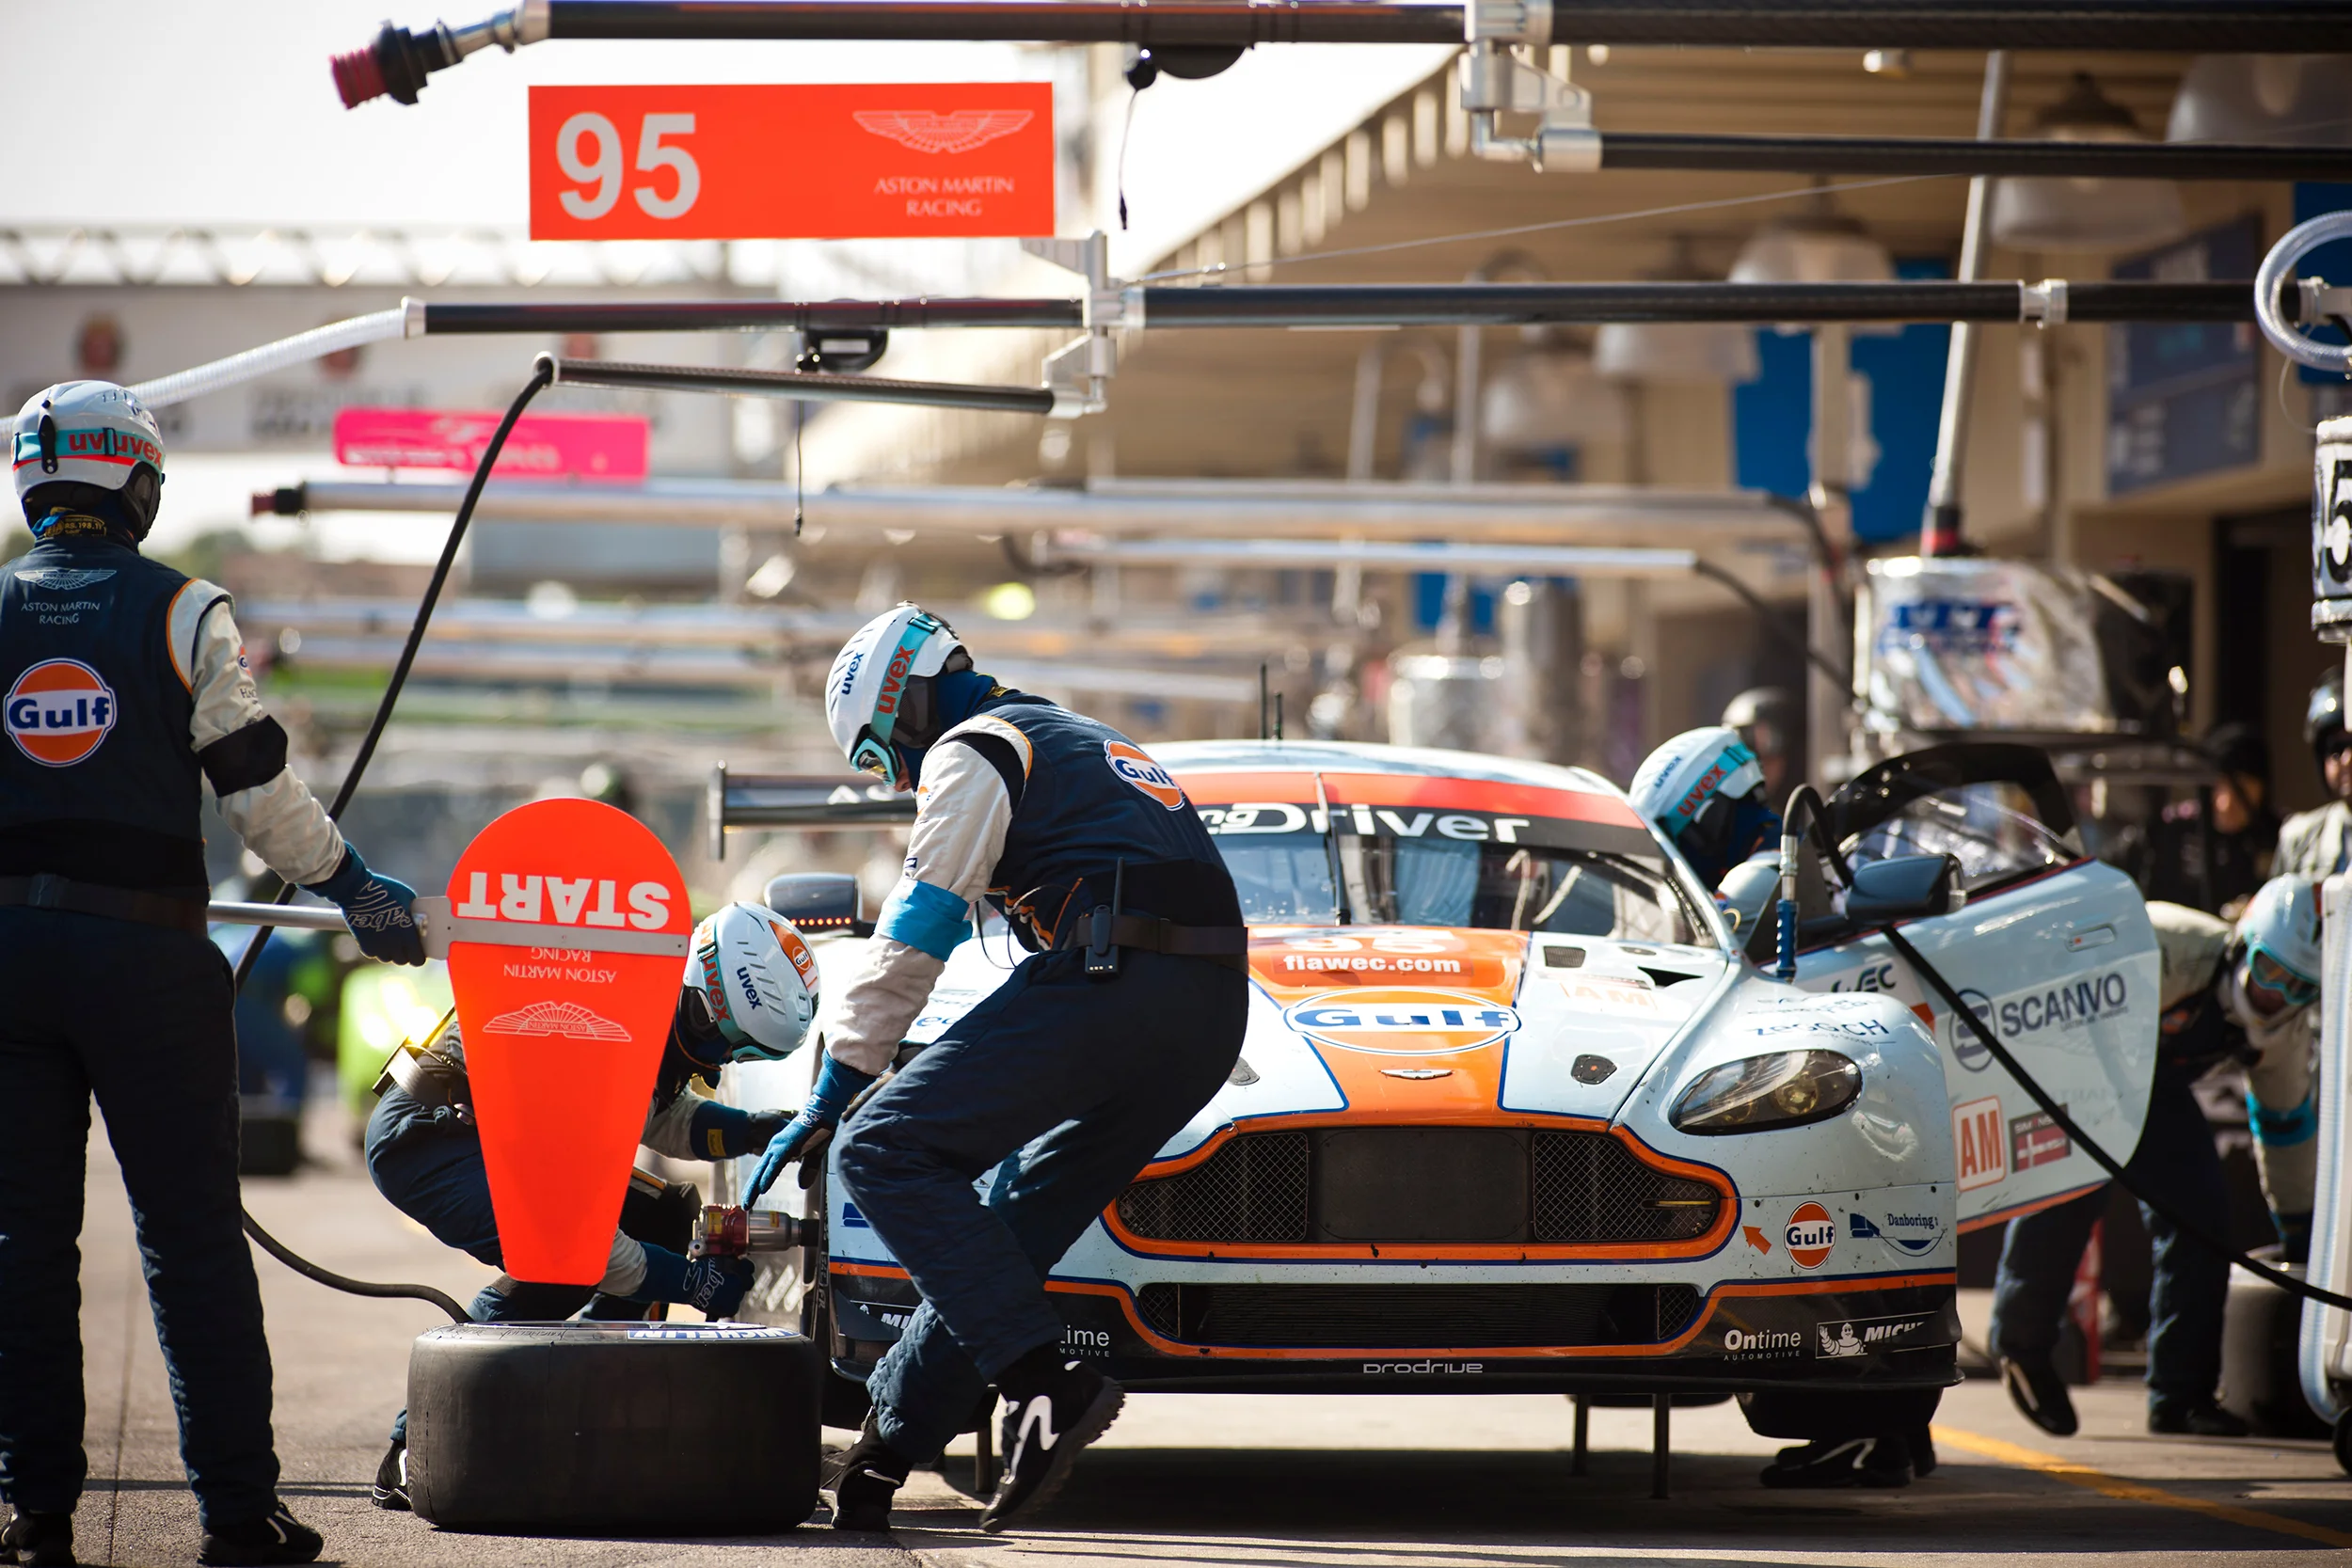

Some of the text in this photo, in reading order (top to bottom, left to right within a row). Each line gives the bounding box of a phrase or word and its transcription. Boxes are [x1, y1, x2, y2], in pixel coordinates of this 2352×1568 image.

[555, 111, 701, 220] 95
[873, 175, 1015, 195] ASTON MARTIN
[906, 198, 982, 217] RACING
[69, 433, 105, 452] uv
[115, 435, 163, 469] uvex
[21, 601, 101, 612] ASTON MARTIN
[39, 613, 80, 626] RACING
[841, 652, 865, 695] uvex
[877, 645, 916, 714] uvex
[8, 697, 110, 729] Gulf
[1115, 759, 1176, 786] Gulf
[1654, 755, 1682, 788] uvex
[1677, 764, 1726, 816] uvex
[1231, 802, 1530, 843] Driver
[457, 871, 671, 930] START
[531, 946, 591, 962] RACING
[795, 952, 809, 965] Gulf
[1283, 955, 1461, 973] fiawec.com
[503, 963, 617, 984] ASTON MARTIN
[703, 954, 731, 1023] uvex
[737, 967, 763, 1010] uvex
[1575, 986, 1649, 1006] AM
[2000, 973, 2126, 1037] SCANVO
[560, 1023, 587, 1033] ASTON
[1294, 1008, 1510, 1027] Gulf
[1961, 1110, 2002, 1179] AM
[1786, 1226, 1834, 1245] Gulf
[1060, 1324, 1110, 1346] ime
[1724, 1329, 1801, 1351] Ontime
[1059, 1348, 1110, 1357] MOTIVE
[1724, 1350, 1801, 1361] AUTOMOTIVE
[1363, 1359, 1483, 1373] prodrive
